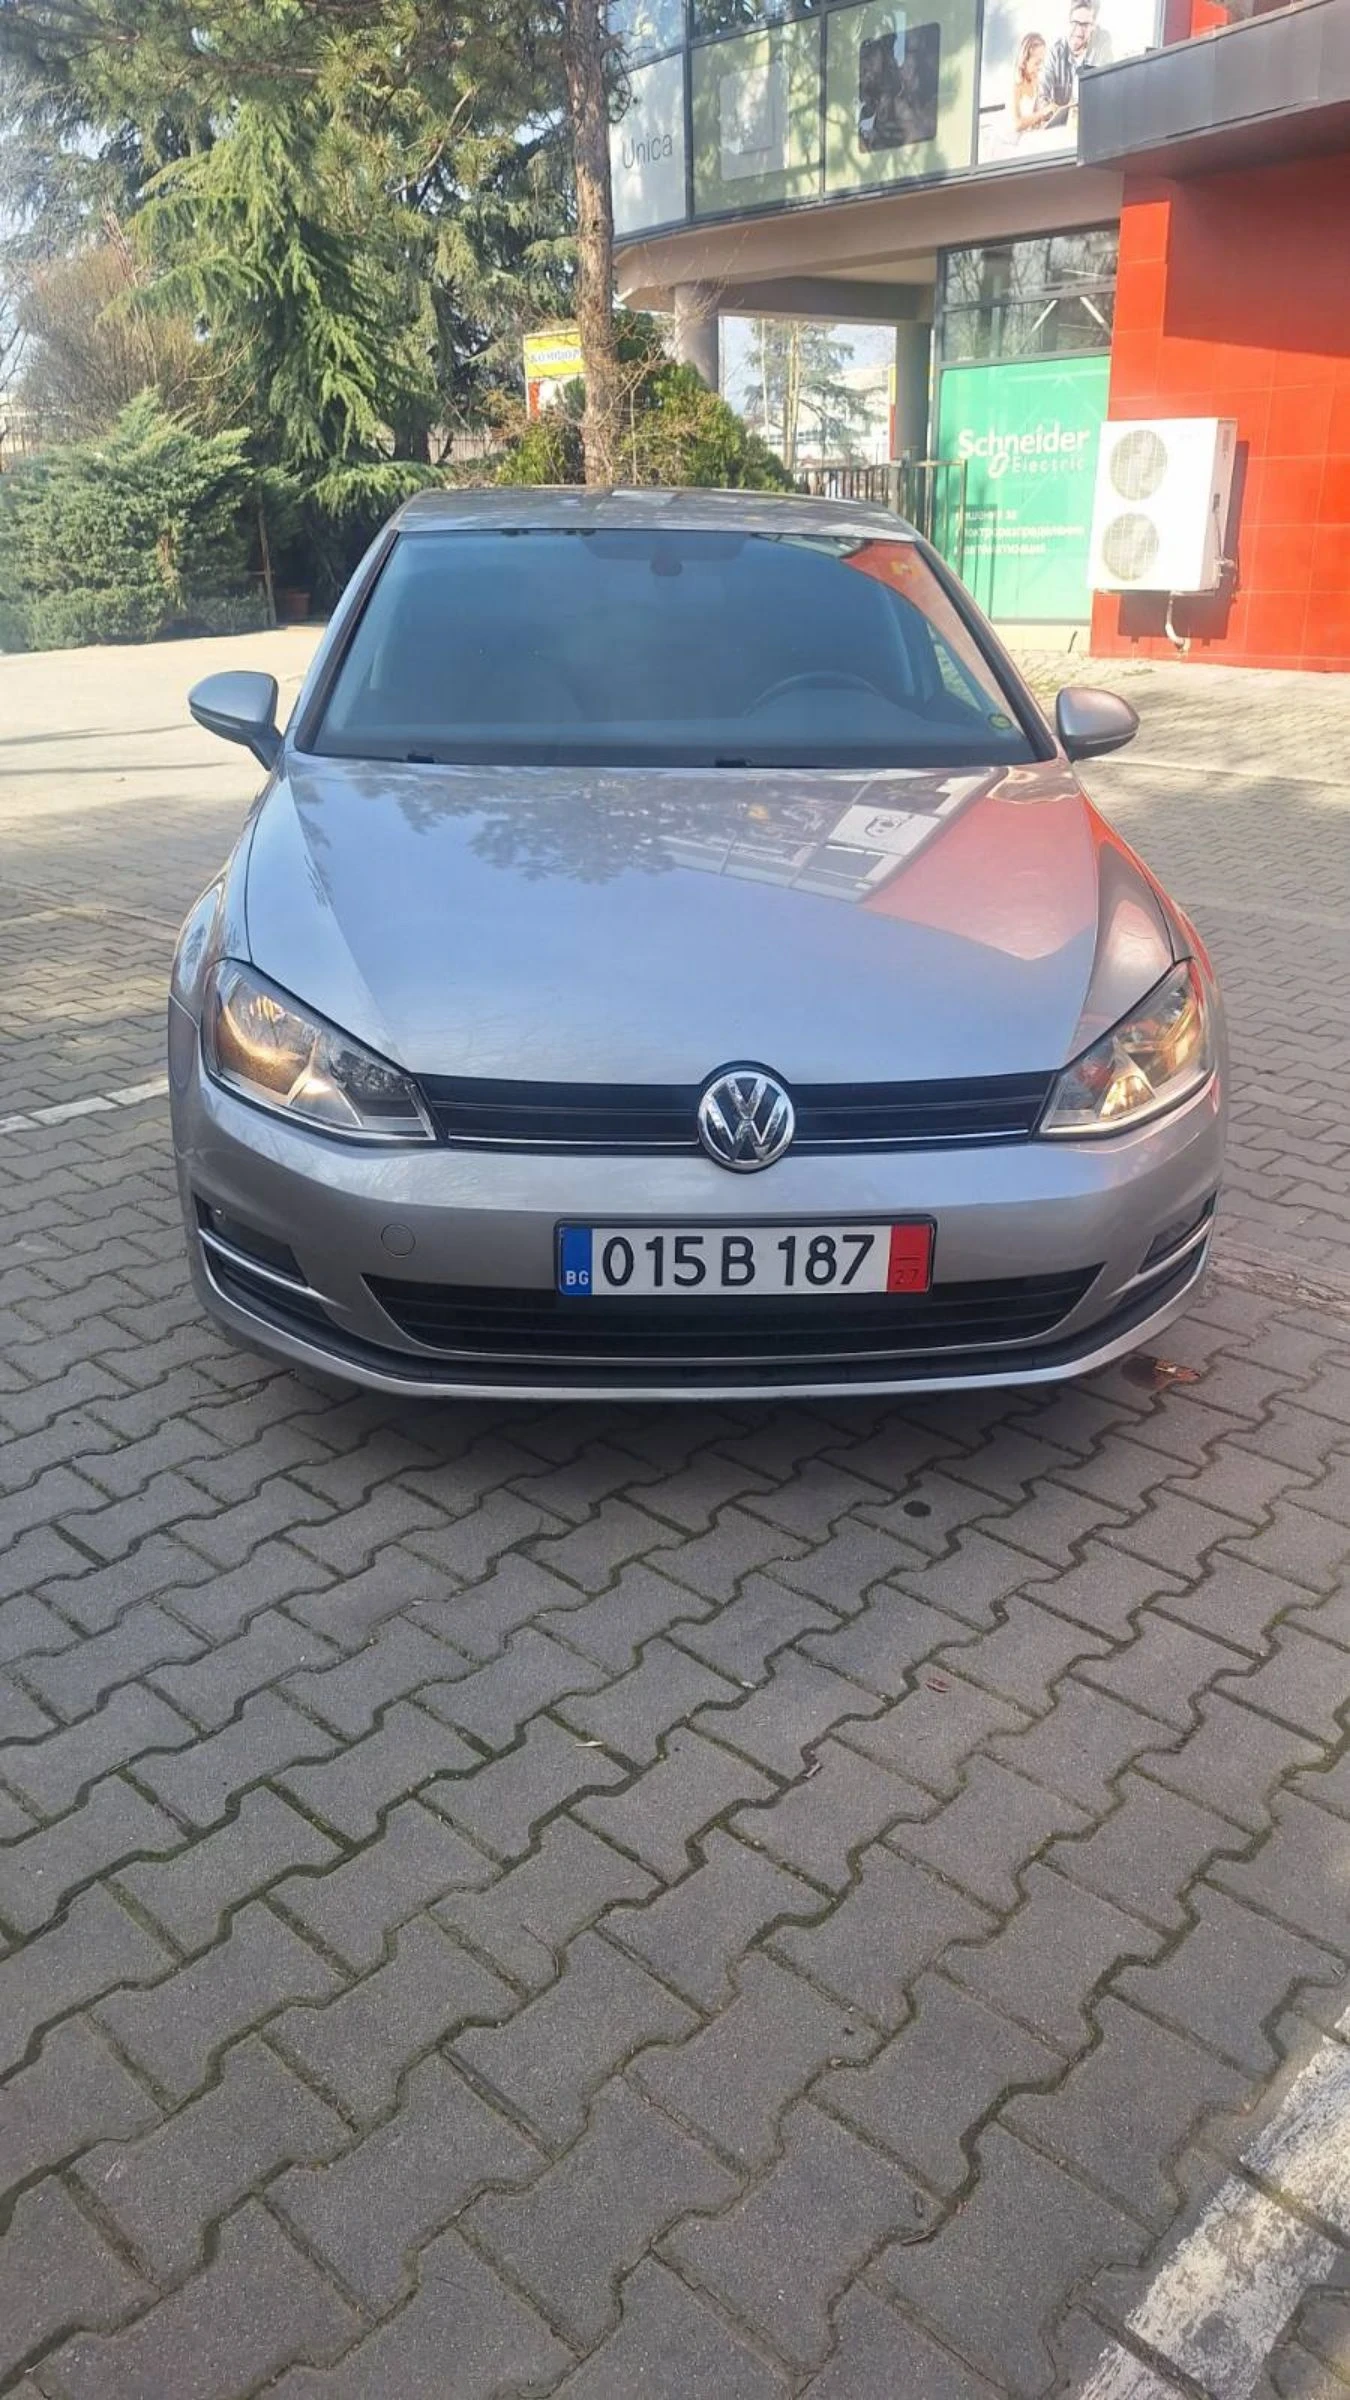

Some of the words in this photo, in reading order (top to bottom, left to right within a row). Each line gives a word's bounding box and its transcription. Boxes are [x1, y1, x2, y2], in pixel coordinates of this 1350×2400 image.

[622, 133, 673, 169] Unica
[957, 420, 1091, 457] Schneider
[1012, 455, 1084, 474] Electric
[565, 1269, 590, 1286] BG
[602, 1235, 706, 1287] 015
[721, 1235, 756, 1287] B
[777, 1234, 875, 1287] 187
